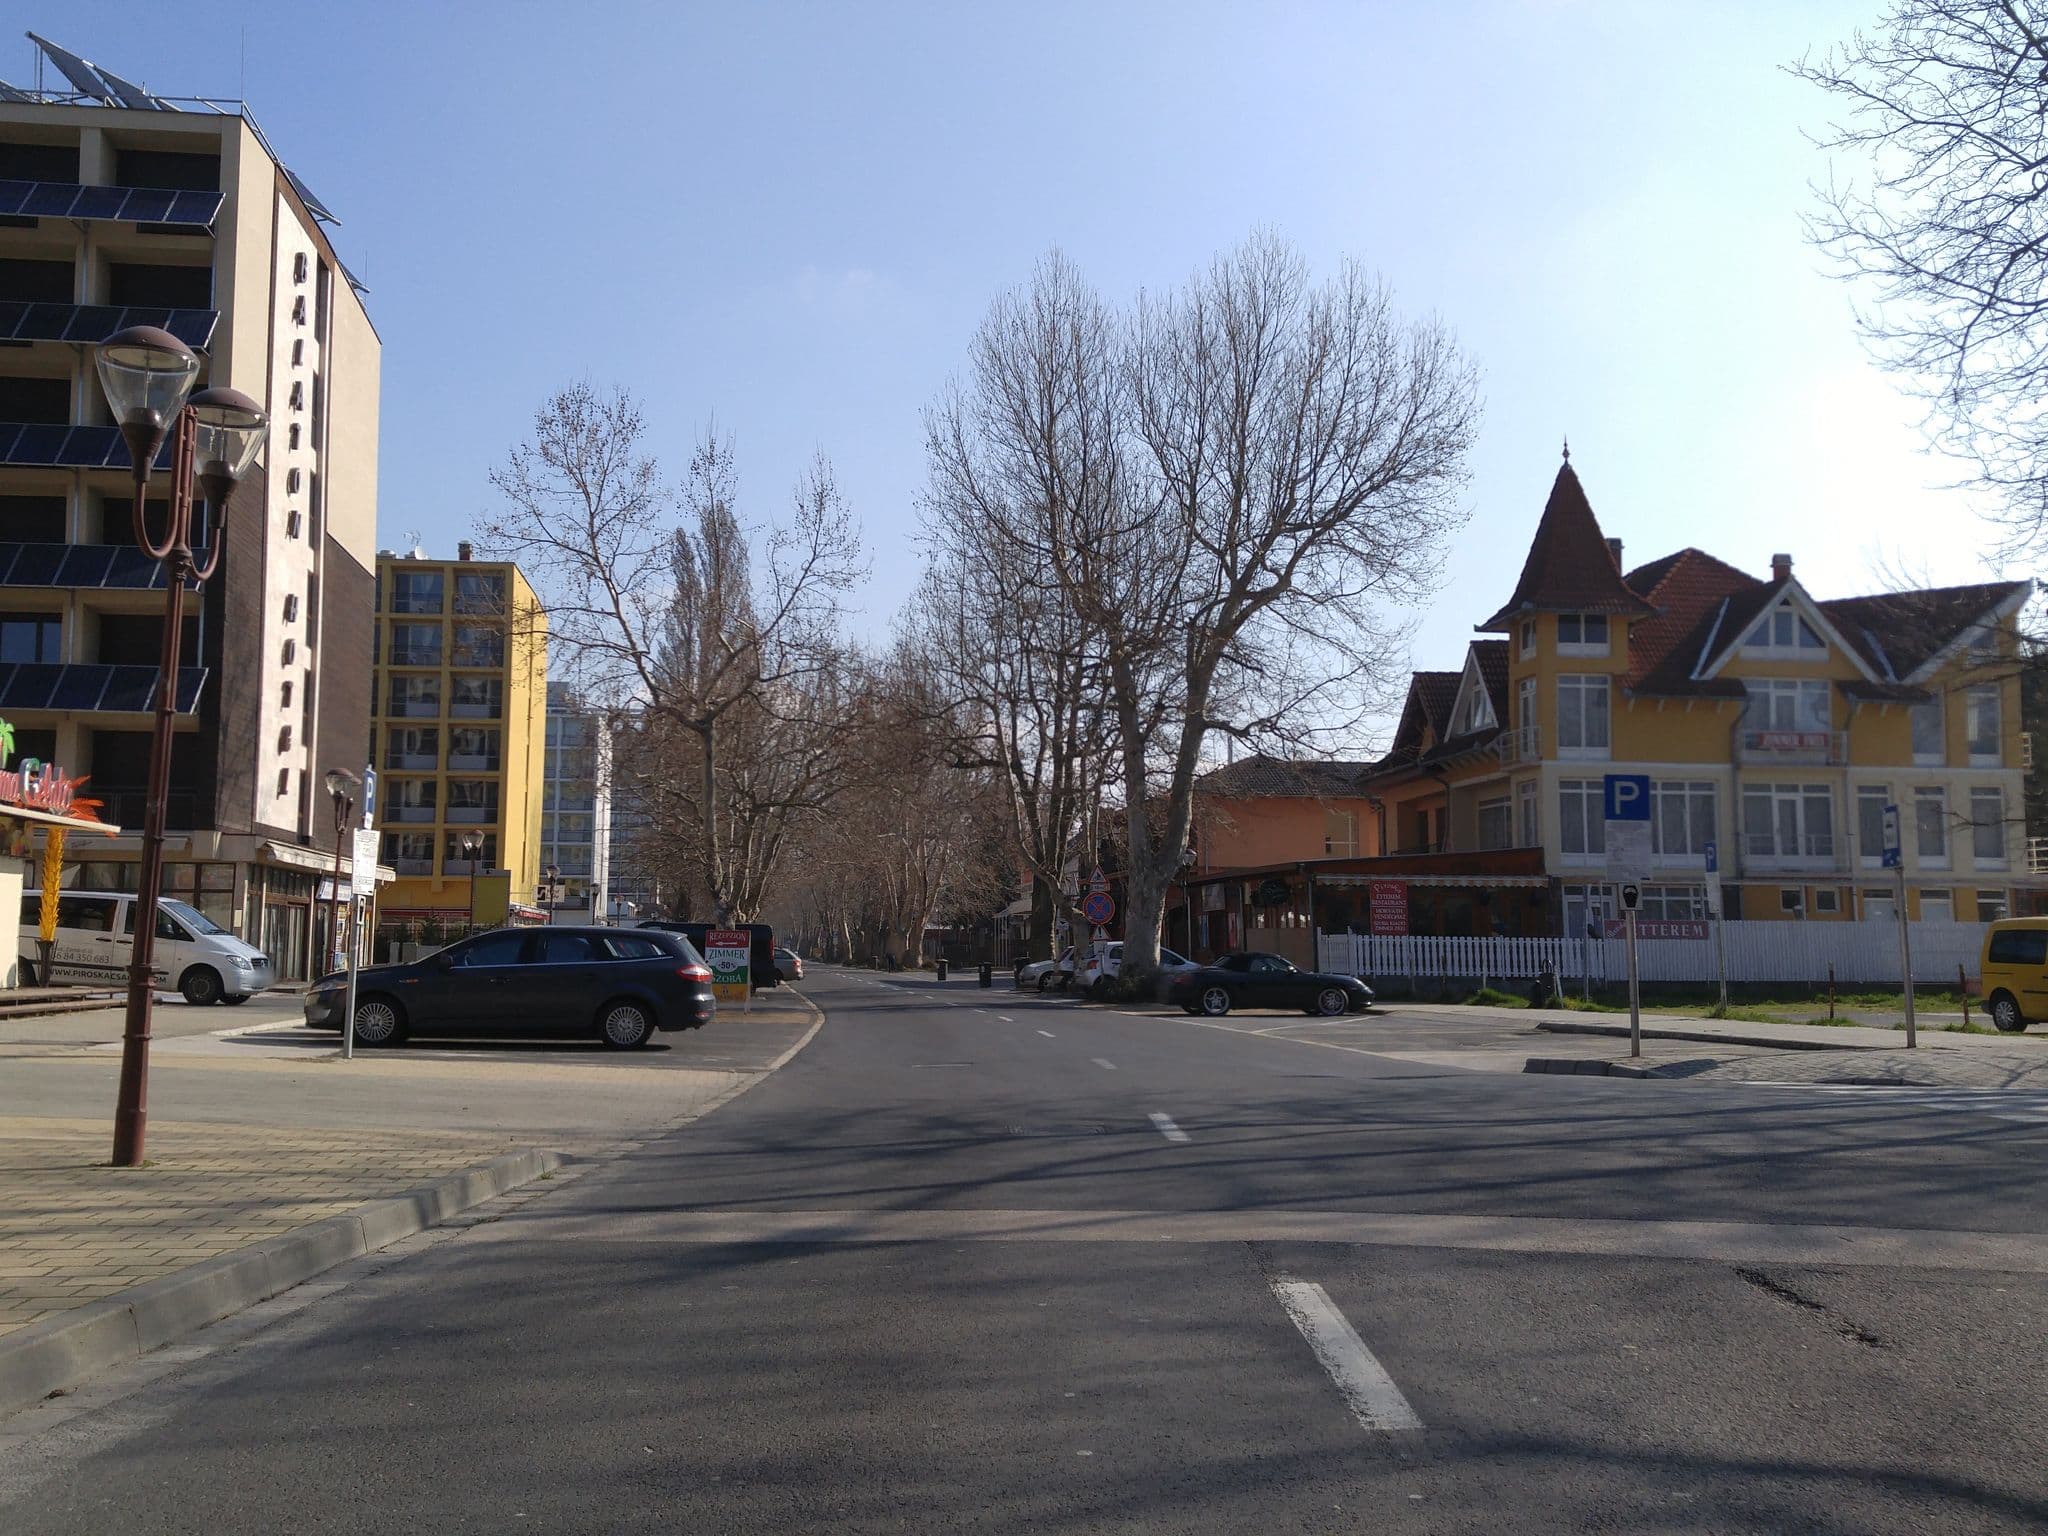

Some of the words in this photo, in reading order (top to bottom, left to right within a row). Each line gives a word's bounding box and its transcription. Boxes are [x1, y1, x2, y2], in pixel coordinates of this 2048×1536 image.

[286, 252, 308, 540] BALATON
[277, 594, 298, 799] HOTEL
[1614, 781, 1640, 815] P
[63, 951, 74, 961] 84
[76, 952, 92, 963] 350
[94, 954, 110, 964] 683
[709, 949, 745, 960] ZIMMER
